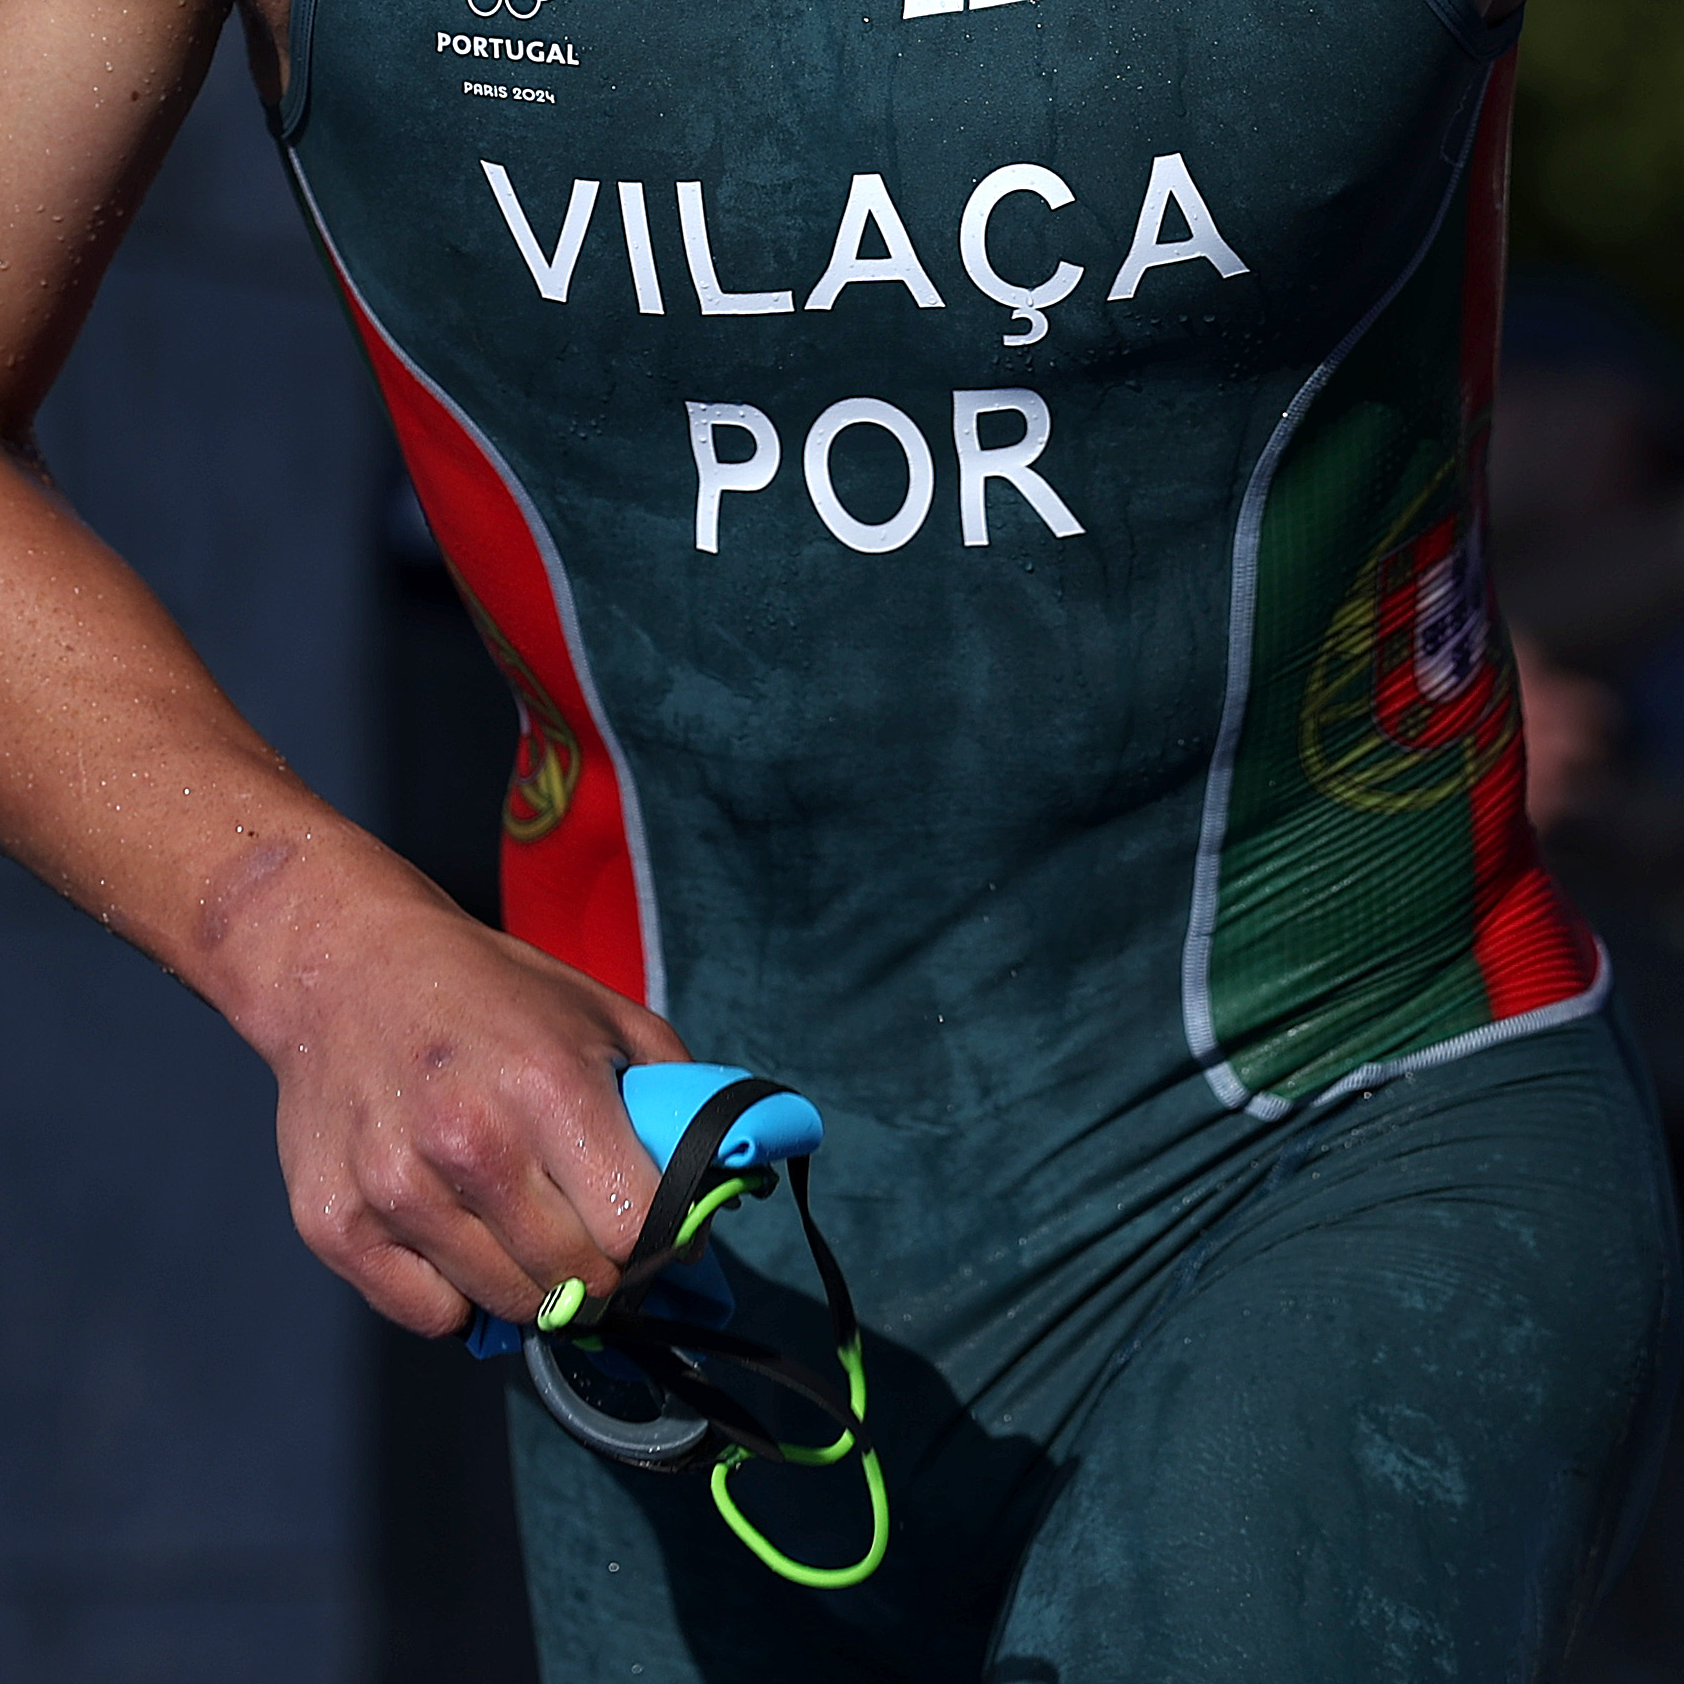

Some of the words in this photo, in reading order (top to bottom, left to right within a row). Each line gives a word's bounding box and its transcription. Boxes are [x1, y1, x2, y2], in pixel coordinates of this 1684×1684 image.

[436, 31, 580, 67] PORTUGAL
[463, 81, 509, 100] PARIS
[511, 86, 556, 105] 2024
[479, 152, 1251, 347] VILAÇA
[684, 387, 1087, 555] POR
